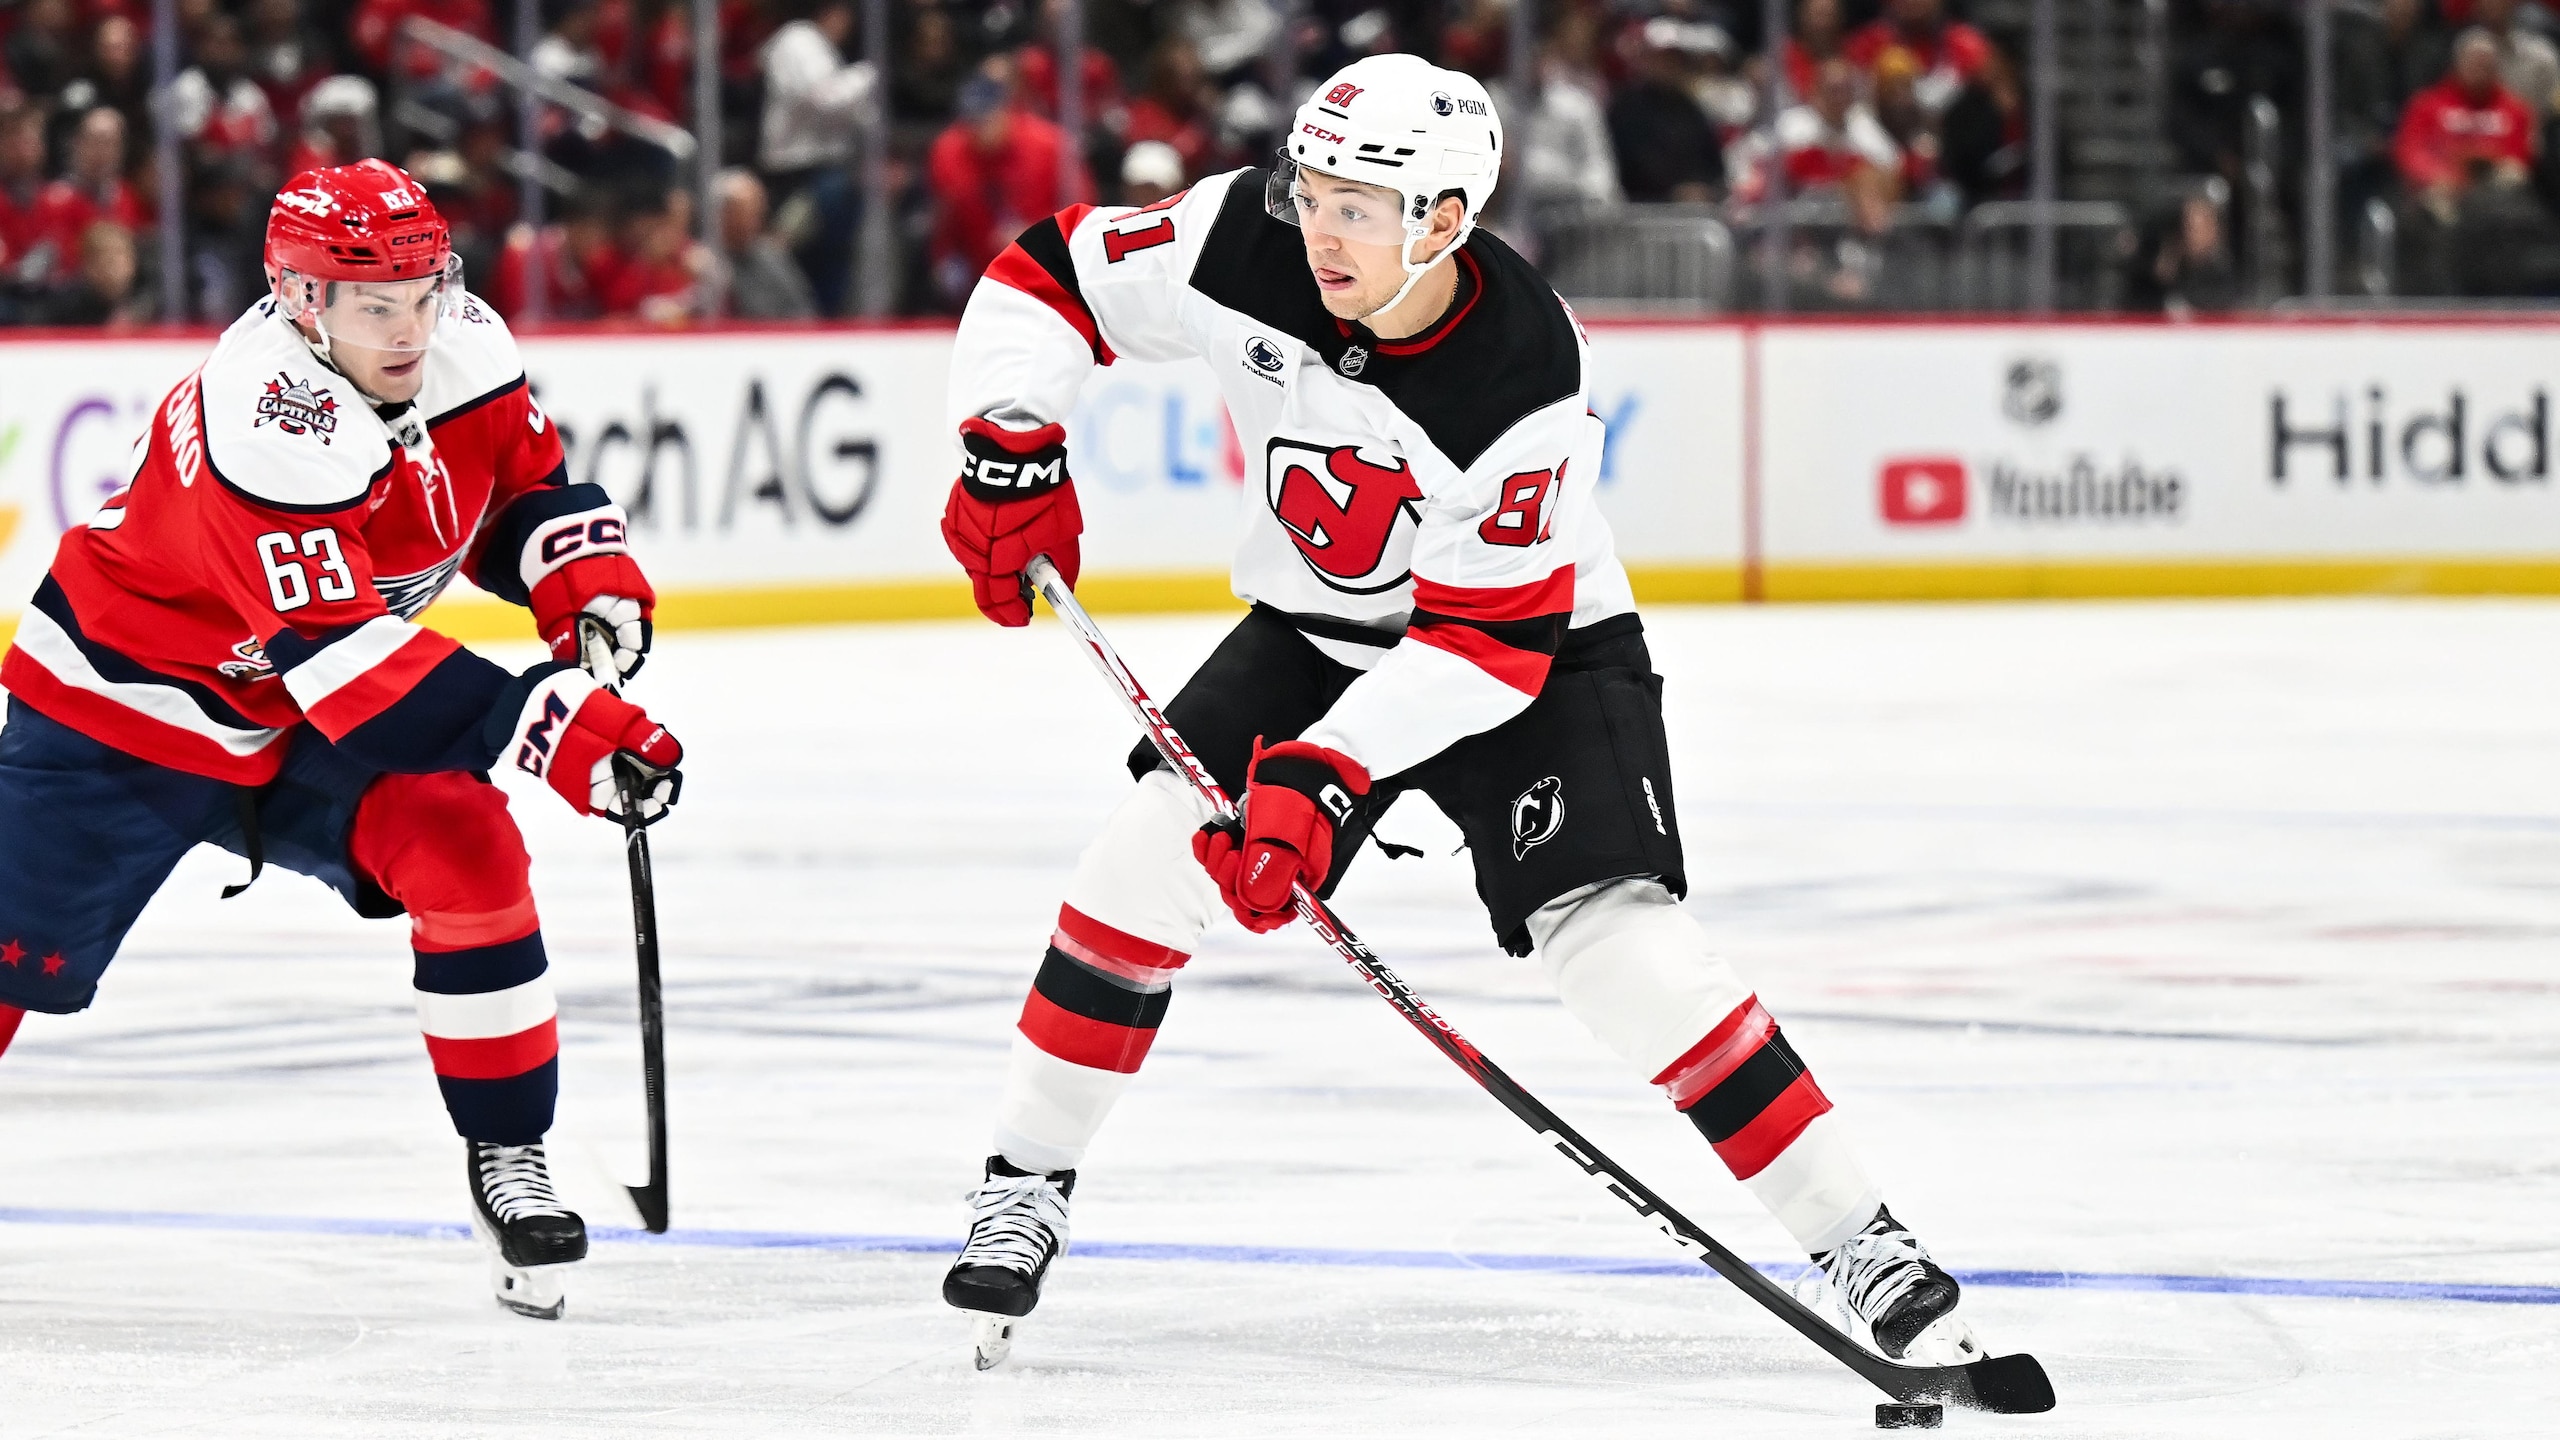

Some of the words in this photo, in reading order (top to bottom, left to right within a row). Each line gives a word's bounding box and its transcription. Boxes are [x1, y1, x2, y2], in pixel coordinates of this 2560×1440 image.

[1325, 82, 1365, 108] 81
[1457, 98, 1488, 117] PGIM
[1302, 123, 1346, 145] CCM
[379, 188, 416, 210] 63
[391, 231, 433, 246] CCM
[1103, 198, 1186, 264] 1
[1241, 360, 1285, 388] Prudential
[259, 397, 336, 432] CAPITALS
[2268, 386, 2549, 482] Hidd
[716, 374, 881, 528] AG
[961, 451, 1061, 489] CCM
[1990, 455, 2179, 518] YouTube
[541, 517, 628, 565] CC
[256, 526, 357, 613] 63
[516, 689, 571, 779] CM
[1138, 698, 1220, 787] CCM
[1292, 891, 1394, 1001] SPEED
[1340, 931, 1453, 1031] JETSPEED
